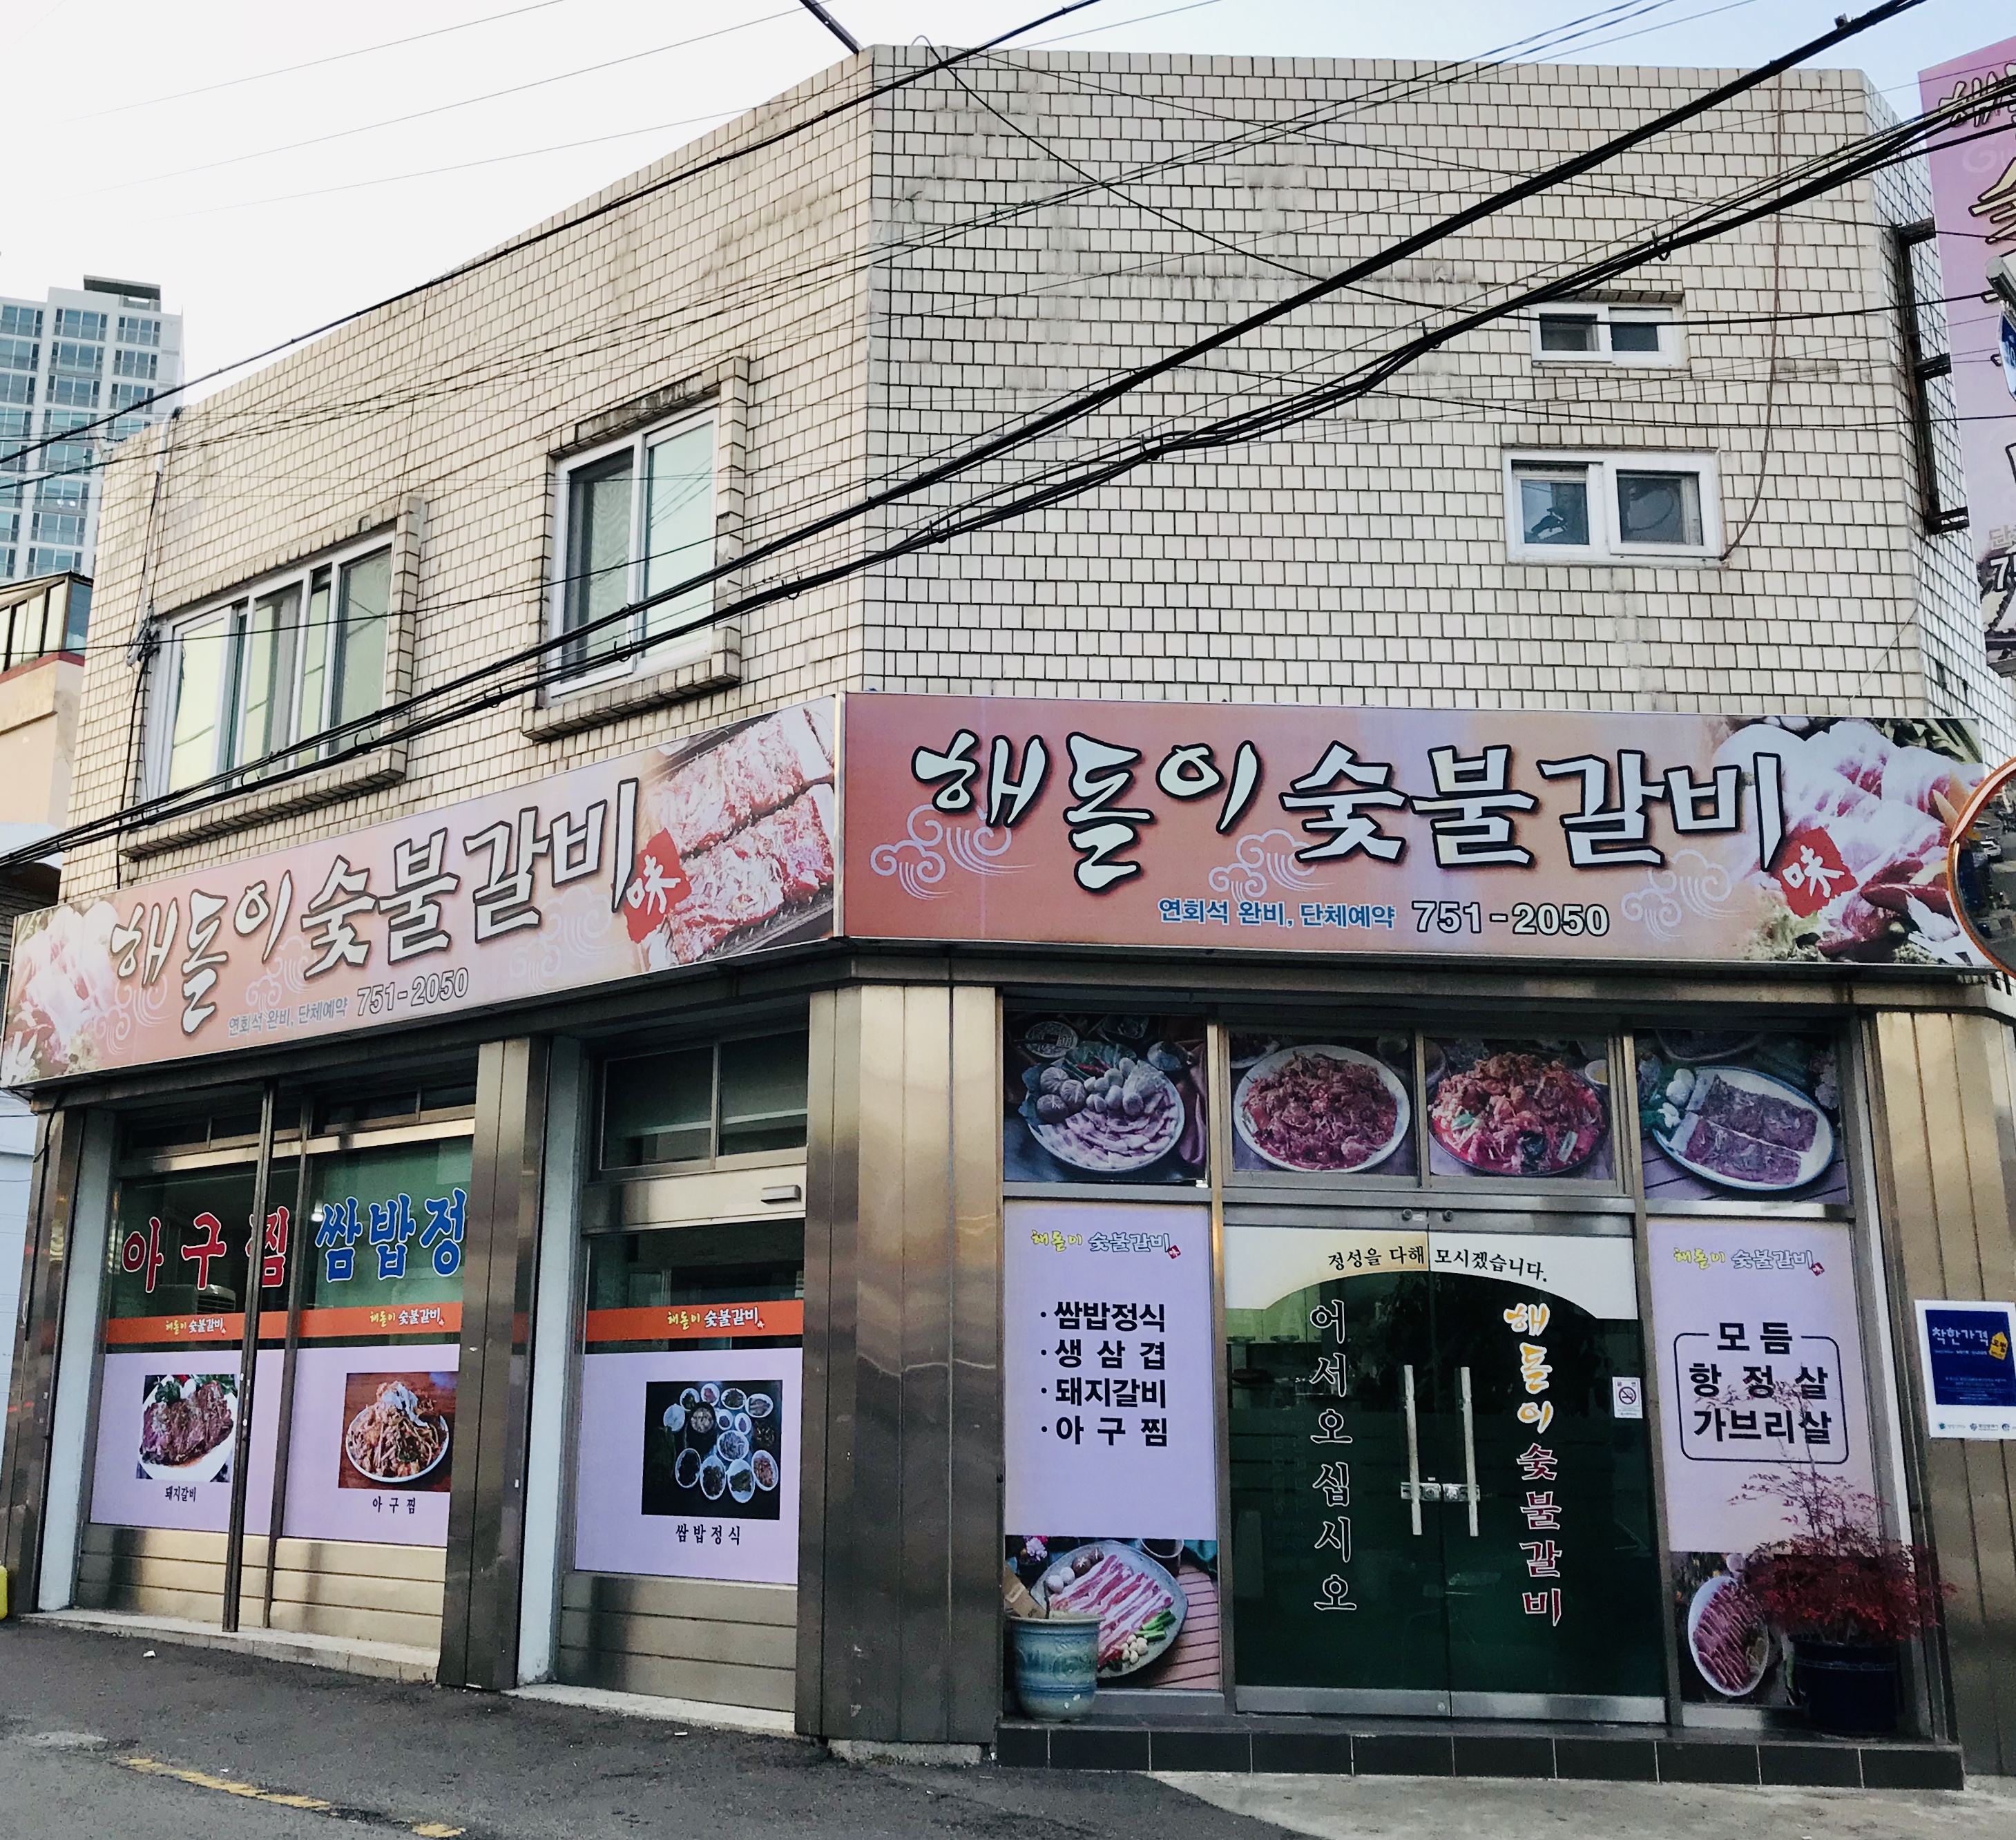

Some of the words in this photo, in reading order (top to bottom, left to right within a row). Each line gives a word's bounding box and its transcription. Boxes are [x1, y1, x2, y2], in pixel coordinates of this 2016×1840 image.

[912, 729, 1263, 892] 해돌이
[1279, 740, 1784, 872] 숯불갈비
[626, 854, 681, 915] 味
[1783, 845, 1845, 897] 味
[110, 869, 294, 1036] 해돌이
[300, 777, 639, 979] 숯불갈비
[1159, 898, 1229, 924] 연회석
[1238, 899, 1294, 928] 완비,
[1300, 901, 1396, 931] 단체예약
[1412, 900, 1609, 937] 751-2050
[228, 1010, 263, 1038] 연회석
[266, 1006, 294, 1032] 완비,
[298, 996, 348, 1026] 단체예약
[357, 968, 469, 1016] 751-2050
[315, 1187, 468, 1283] 쌈밥정
[1031, 1229, 1082, 1252] 해돌이
[1088, 1232, 1171, 1253] 숯불갈비
[1327, 1247, 1382, 1272] 정성을
[1390, 1246, 1425, 1265] 다해
[1434, 1247, 1548, 1283] 모시겠습니다.
[1674, 1247, 1725, 1269] 해돌이
[1731, 1249, 1814, 1269] 숯불갈비
[189, 1316, 224, 1333] 숯불갈비
[398, 1307, 441, 1326] 숯불갈비
[704, 1307, 759, 1329] 숯불갈비
[1054, 1301, 1166, 1332] 쌈밥정식
[1932, 1327, 1988, 1346] 착한가격
[1504, 1302, 1554, 1433] 해돌이
[1055, 1377, 1166, 1408] 돼지갈비
[1693, 1408, 1832, 1444] 가브리살
[1309, 1299, 1357, 1611] 어서오십시오
[165, 1486, 196, 1502] 돼지갈비
[675, 1523, 742, 1546] 쌈밥정식
[1516, 1442, 1563, 1627] 숯불갈비
